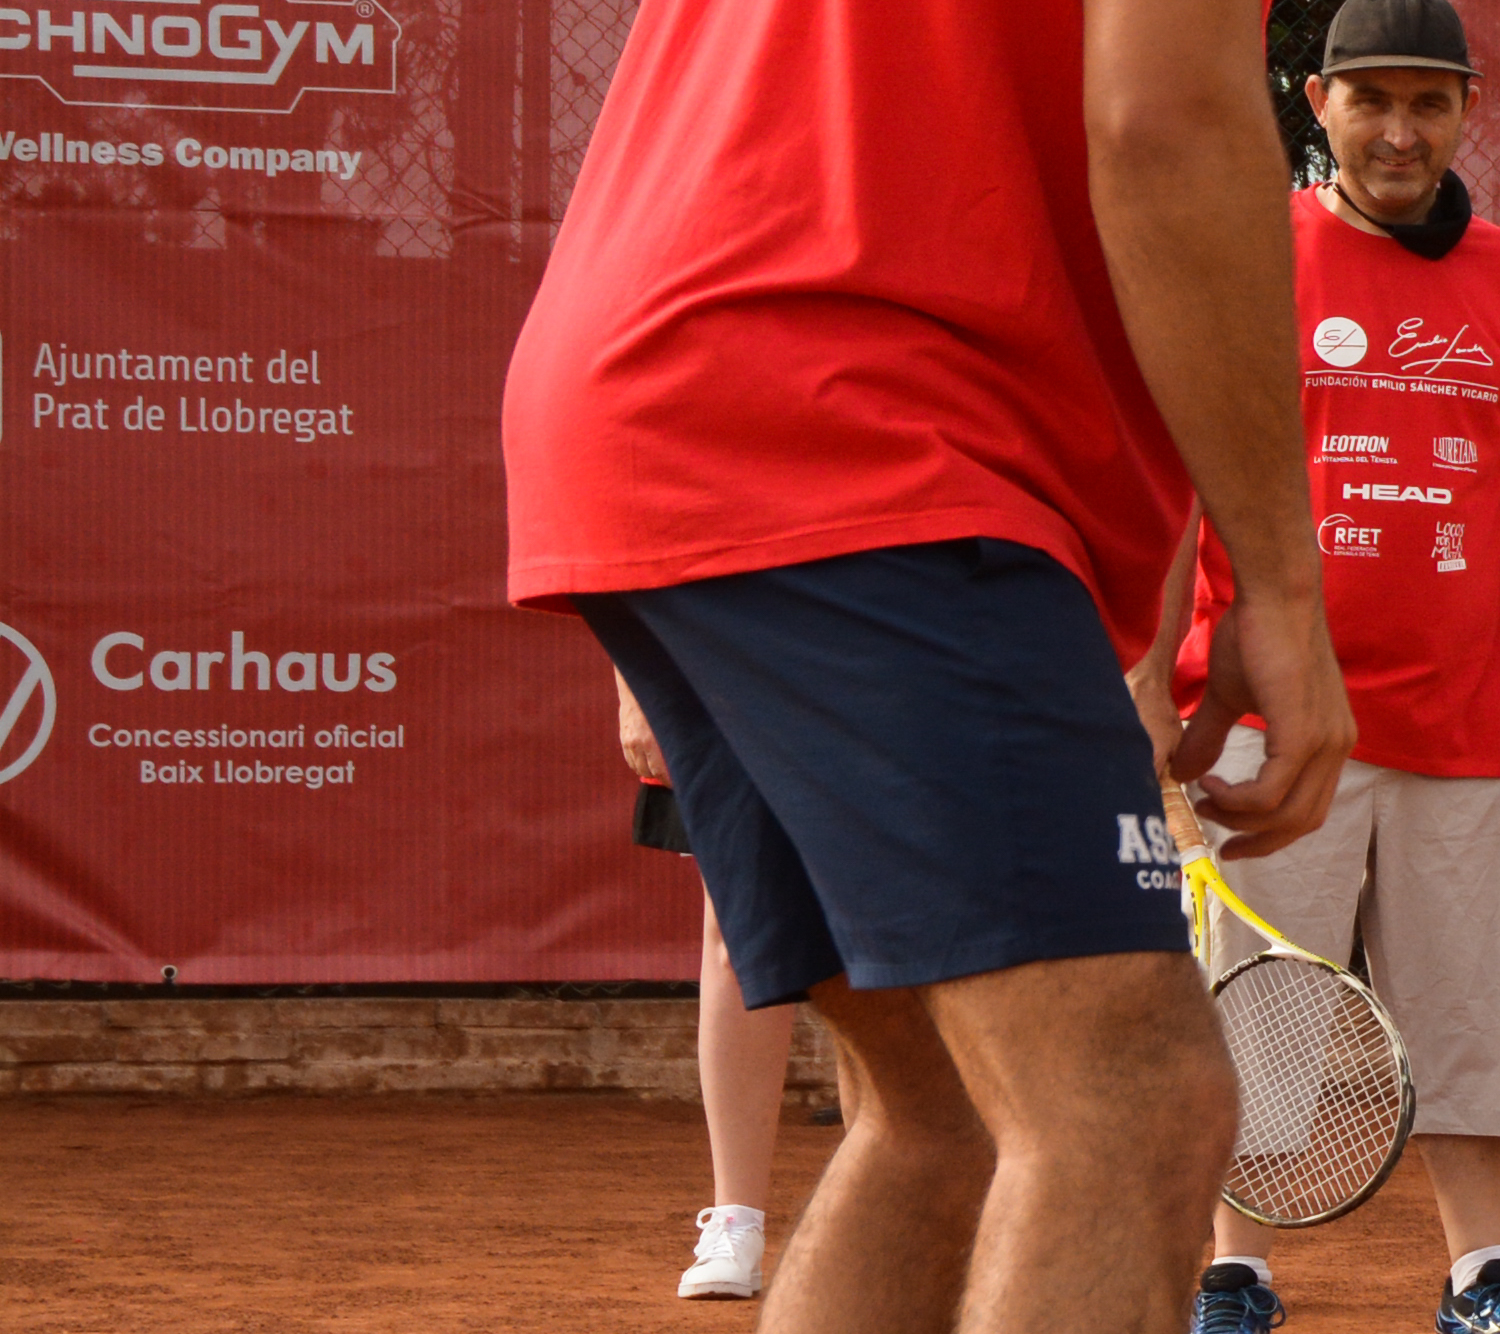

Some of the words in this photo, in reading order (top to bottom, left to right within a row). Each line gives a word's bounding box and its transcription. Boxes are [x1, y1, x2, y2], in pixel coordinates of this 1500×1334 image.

[0, 3, 375, 84] CHNOGYM
[175, 138, 362, 180] Company
[33, 343, 255, 386] Ajuntament
[266, 350, 321, 385] del
[1305, 375, 1368, 388] FUNDACIÓN
[1372, 378, 1406, 392] EMILIO
[1410, 380, 1458, 396] SÁNCHEZ
[1461, 387, 1499, 403] VICARIO
[33, 394, 109, 431] Prat
[123, 396, 166, 431] de
[180, 396, 354, 443] Llobregat
[1321, 435, 1390, 453] LEOTRON
[1342, 483, 1453, 505] HEAD
[1335, 527, 1382, 545] RFET
[90, 630, 398, 693] Carhaus
[88, 722, 305, 750] Concessionari
[313, 723, 405, 750] oficial
[140, 760, 204, 785] Baix
[213, 760, 356, 789] Llobregat
